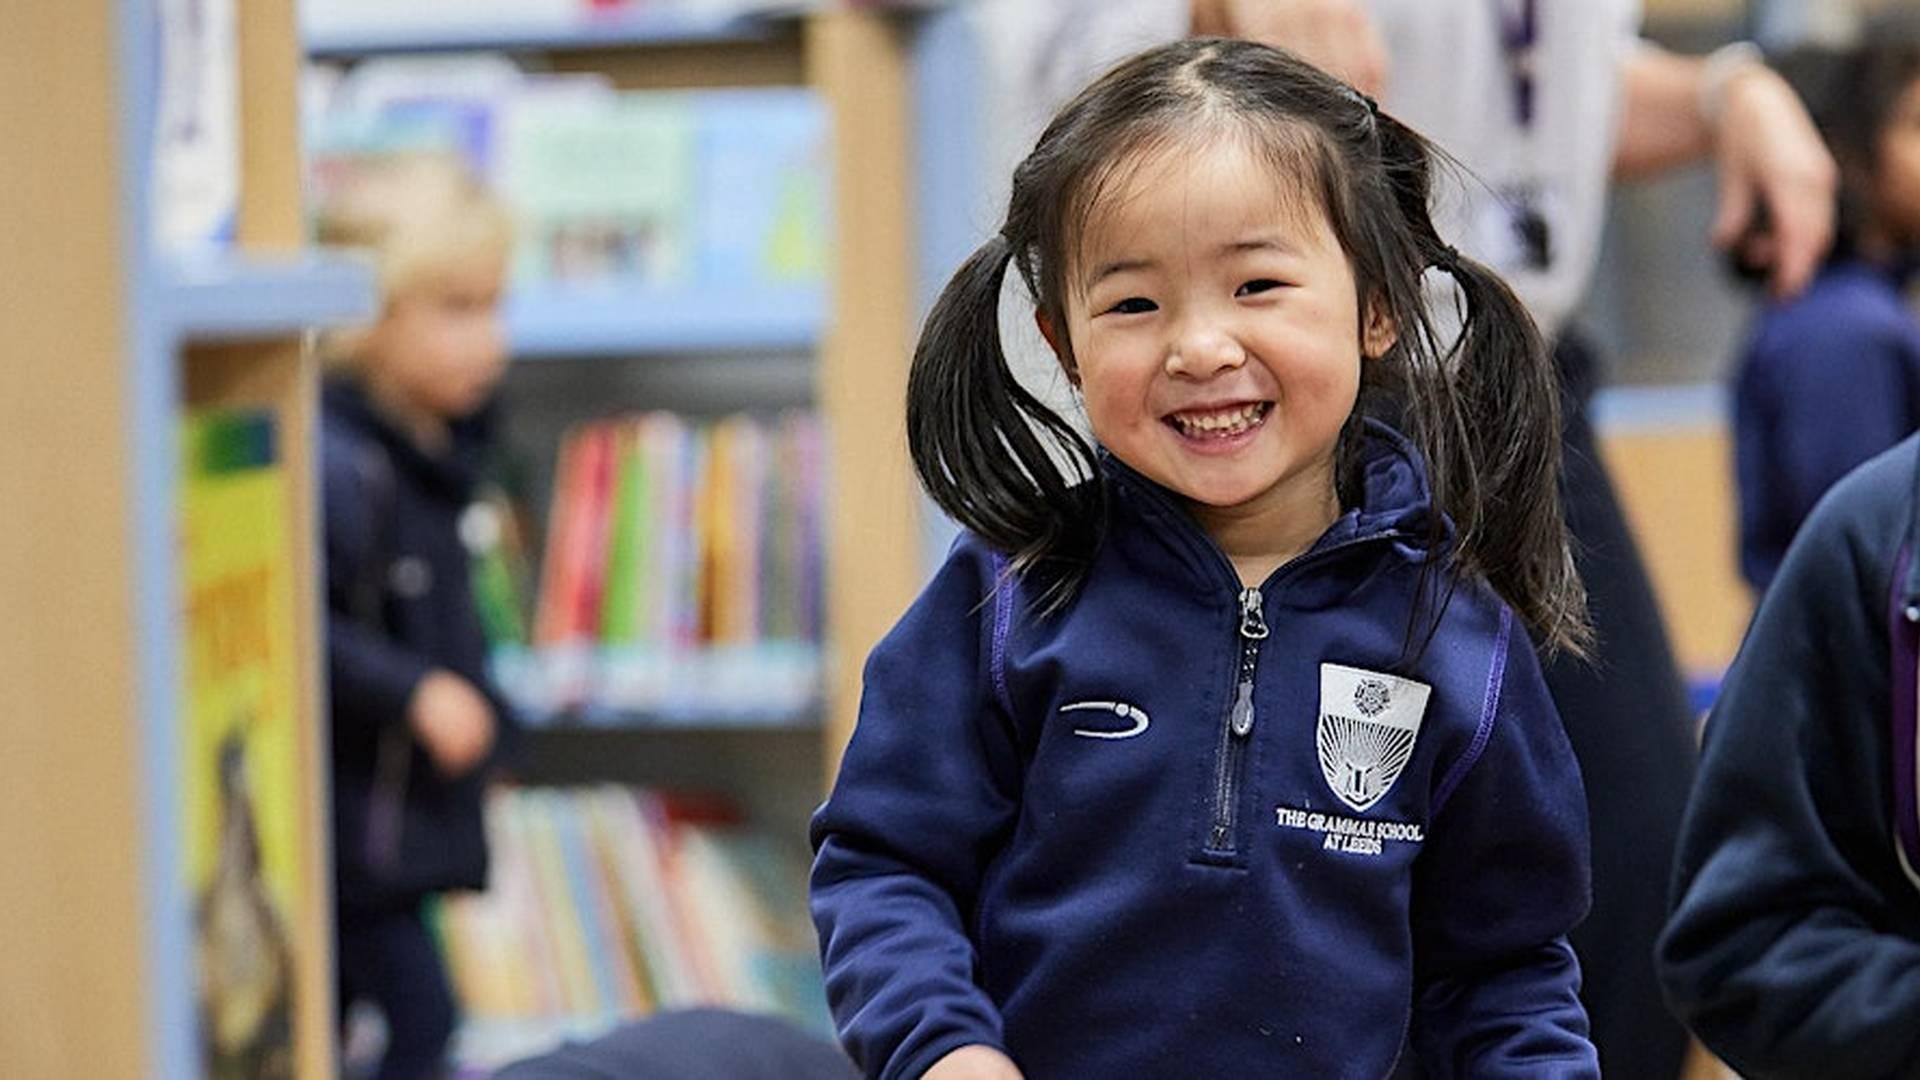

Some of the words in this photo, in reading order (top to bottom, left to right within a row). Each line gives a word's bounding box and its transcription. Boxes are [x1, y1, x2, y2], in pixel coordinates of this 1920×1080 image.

[1276, 808, 1306, 828] THE
[1307, 813, 1375, 838] GRAMMAR
[1376, 821, 1424, 841] SCHOOL
[1323, 834, 1342, 850] AT
[1342, 837, 1382, 854] LEEDS
